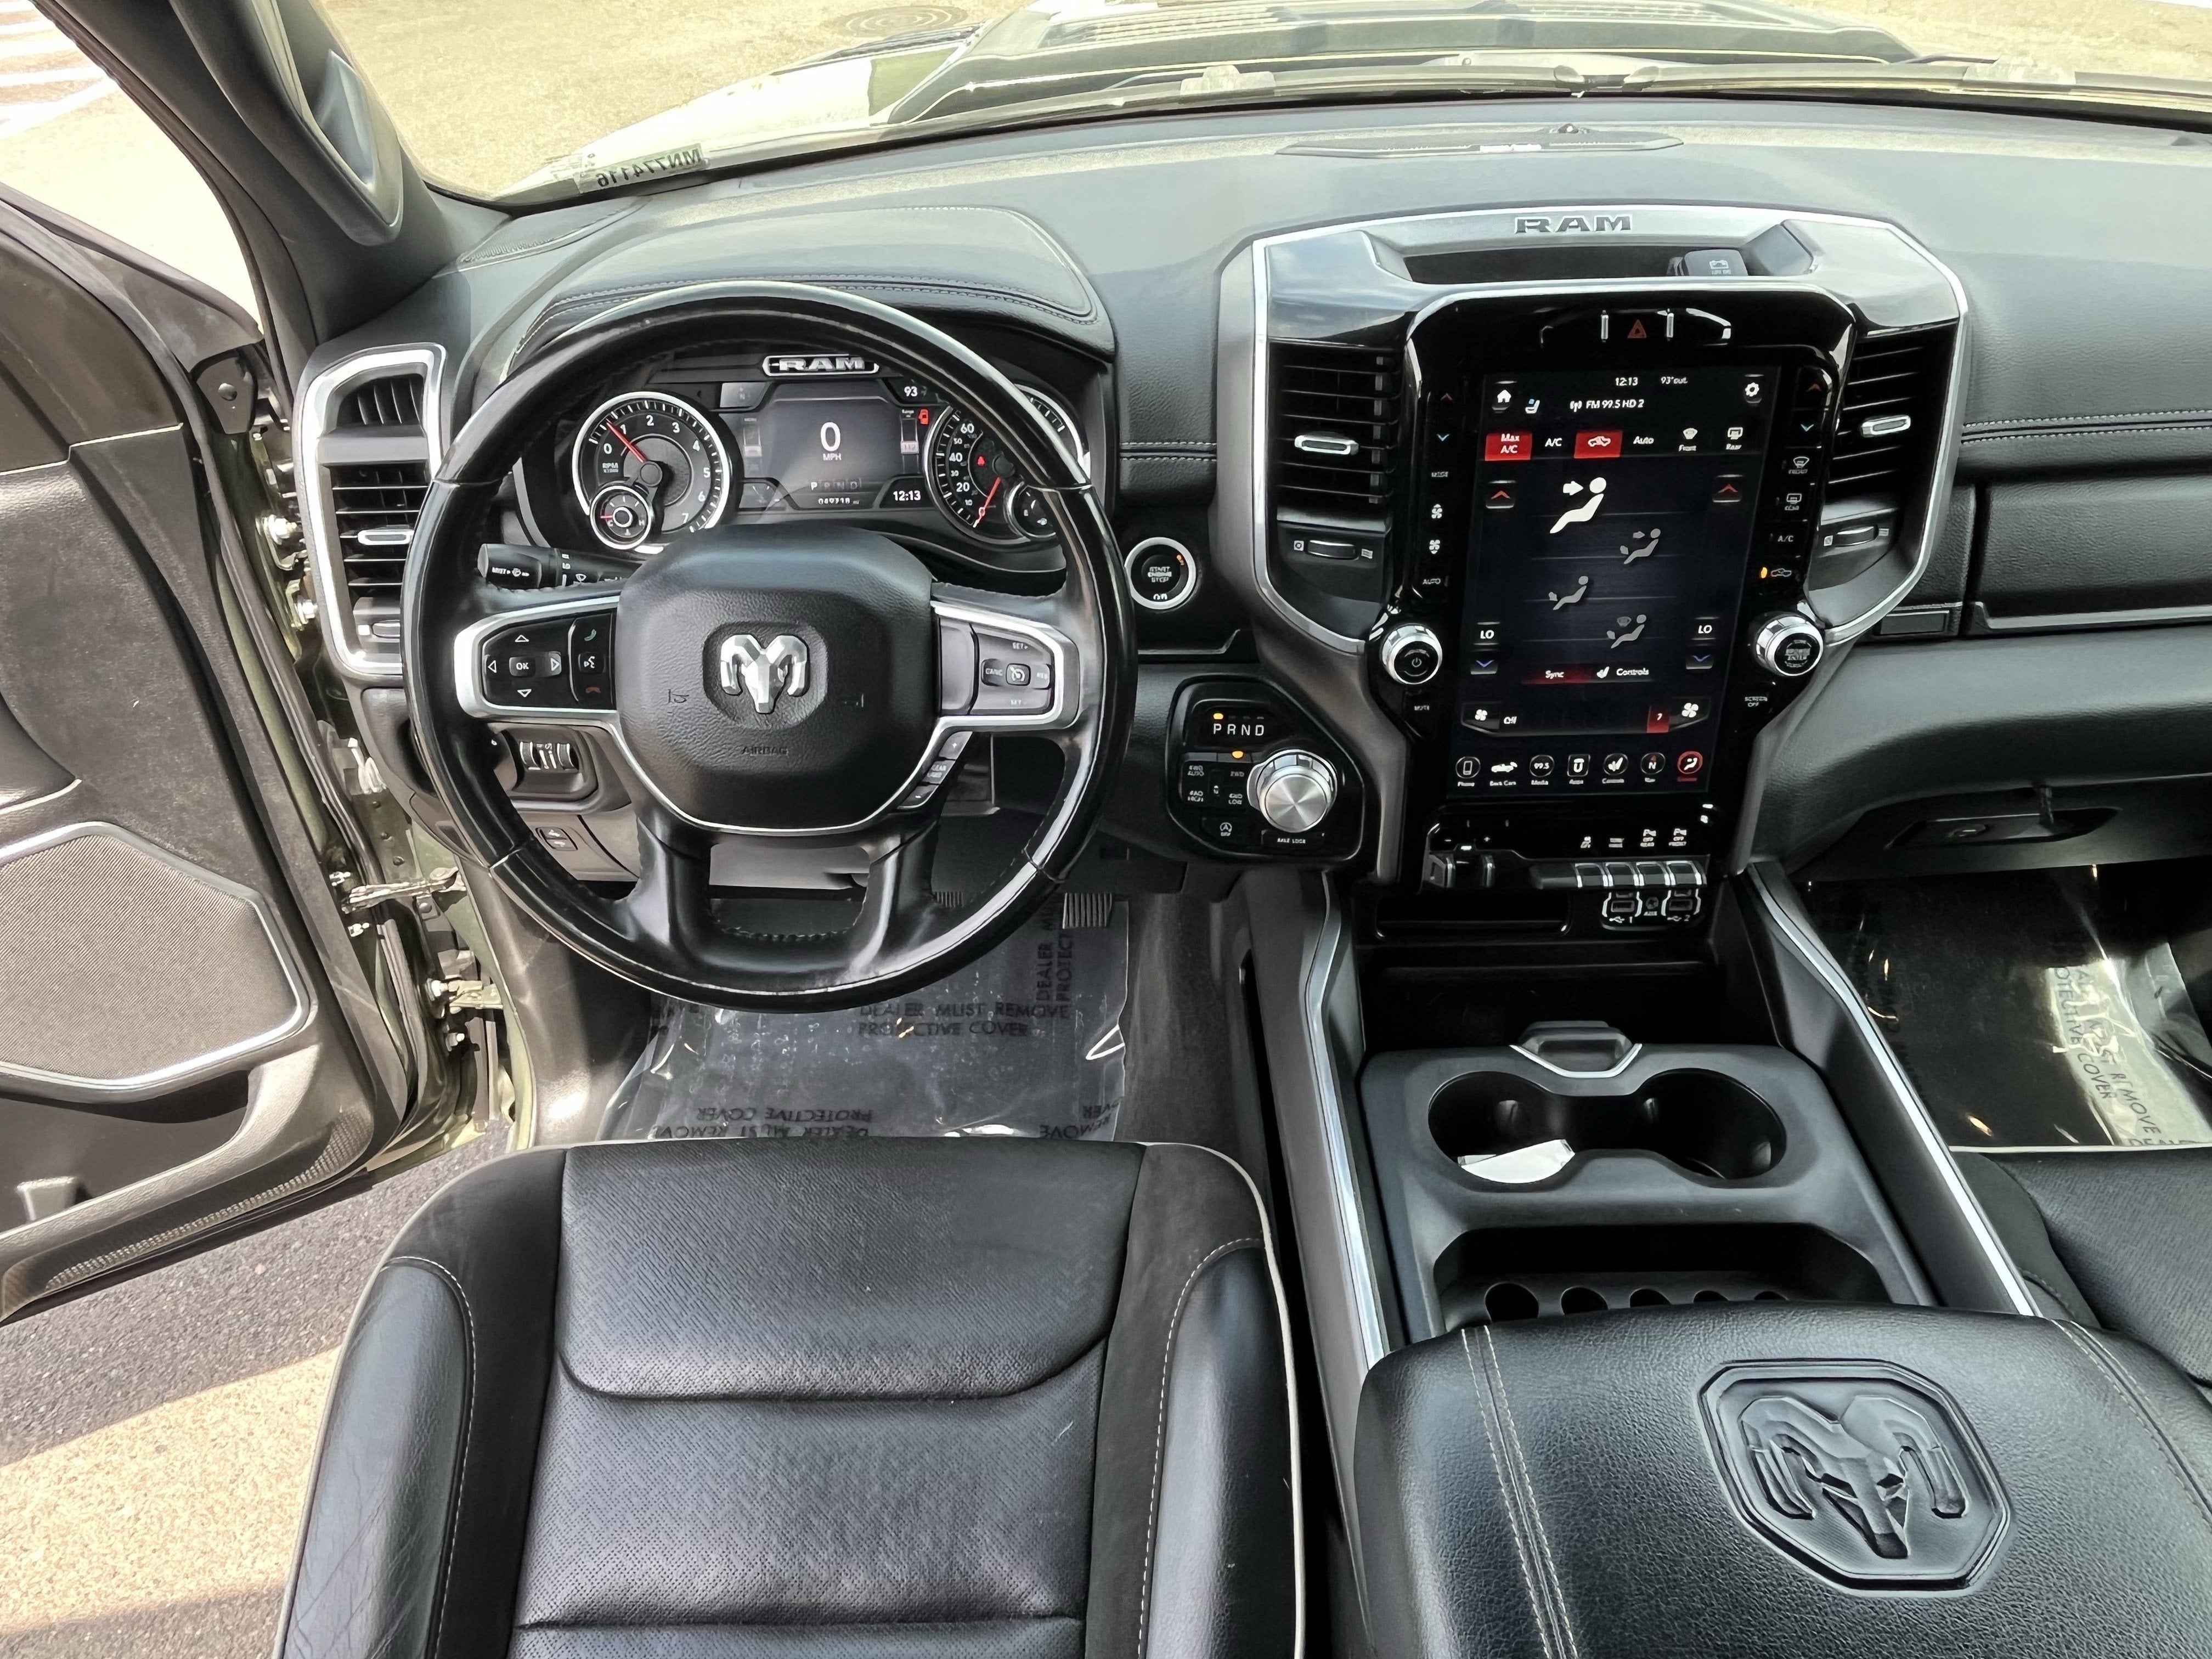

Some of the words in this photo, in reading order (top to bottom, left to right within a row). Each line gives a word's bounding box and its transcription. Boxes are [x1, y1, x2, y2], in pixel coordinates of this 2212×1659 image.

[1514, 215, 1632, 234] RAM
[779, 357, 865, 371] RAM
[904, 386, 918, 397] 93
[1586, 400, 1600, 409] FM
[1622, 399, 1637, 408] HD
[1638, 399, 1645, 408] 2
[646, 414, 654, 427] 2
[620, 424, 627, 435] 1
[672, 421, 680, 433] 3
[960, 422, 975, 433] 60
[820, 422, 841, 452] 0
[1501, 433, 1520, 442] Max
[1545, 438, 1562, 447] A/C
[603, 443, 612, 454] 0
[692, 439, 701, 452] 4
[1500, 445, 1518, 454] A/C
[949, 452, 963, 462] 40
[703, 467, 711, 478] 5
[811, 482, 817, 490] P
[956, 482, 970, 492] 20
[698, 490, 706, 502] 6
[893, 490, 921, 501] 12:13
[681, 512, 689, 524] 7
[1480, 629, 1495, 640] LO
[1698, 624, 1713, 634] LO
[517, 662, 529, 670] OK
[1616, 667, 1650, 676] Controls
[1545, 670, 1565, 680] Sync
[1503, 715, 1517, 725] Off
[1214, 723, 1222, 735] P
[1227, 724, 1236, 735] R
[1242, 724, 1250, 736] N
[1255, 725, 1264, 736] D
[1056, 933, 1072, 1001] PROTECT
[860, 1002, 924, 1017] DEALER
[936, 1002, 985, 1017] MUST
[995, 1002, 1071, 1019] REMOVE
[969, 1020, 1028, 1037] COVER
[697, 1107, 757, 1121] COVER
[765, 1108, 872, 1122] PROTECTIVE
